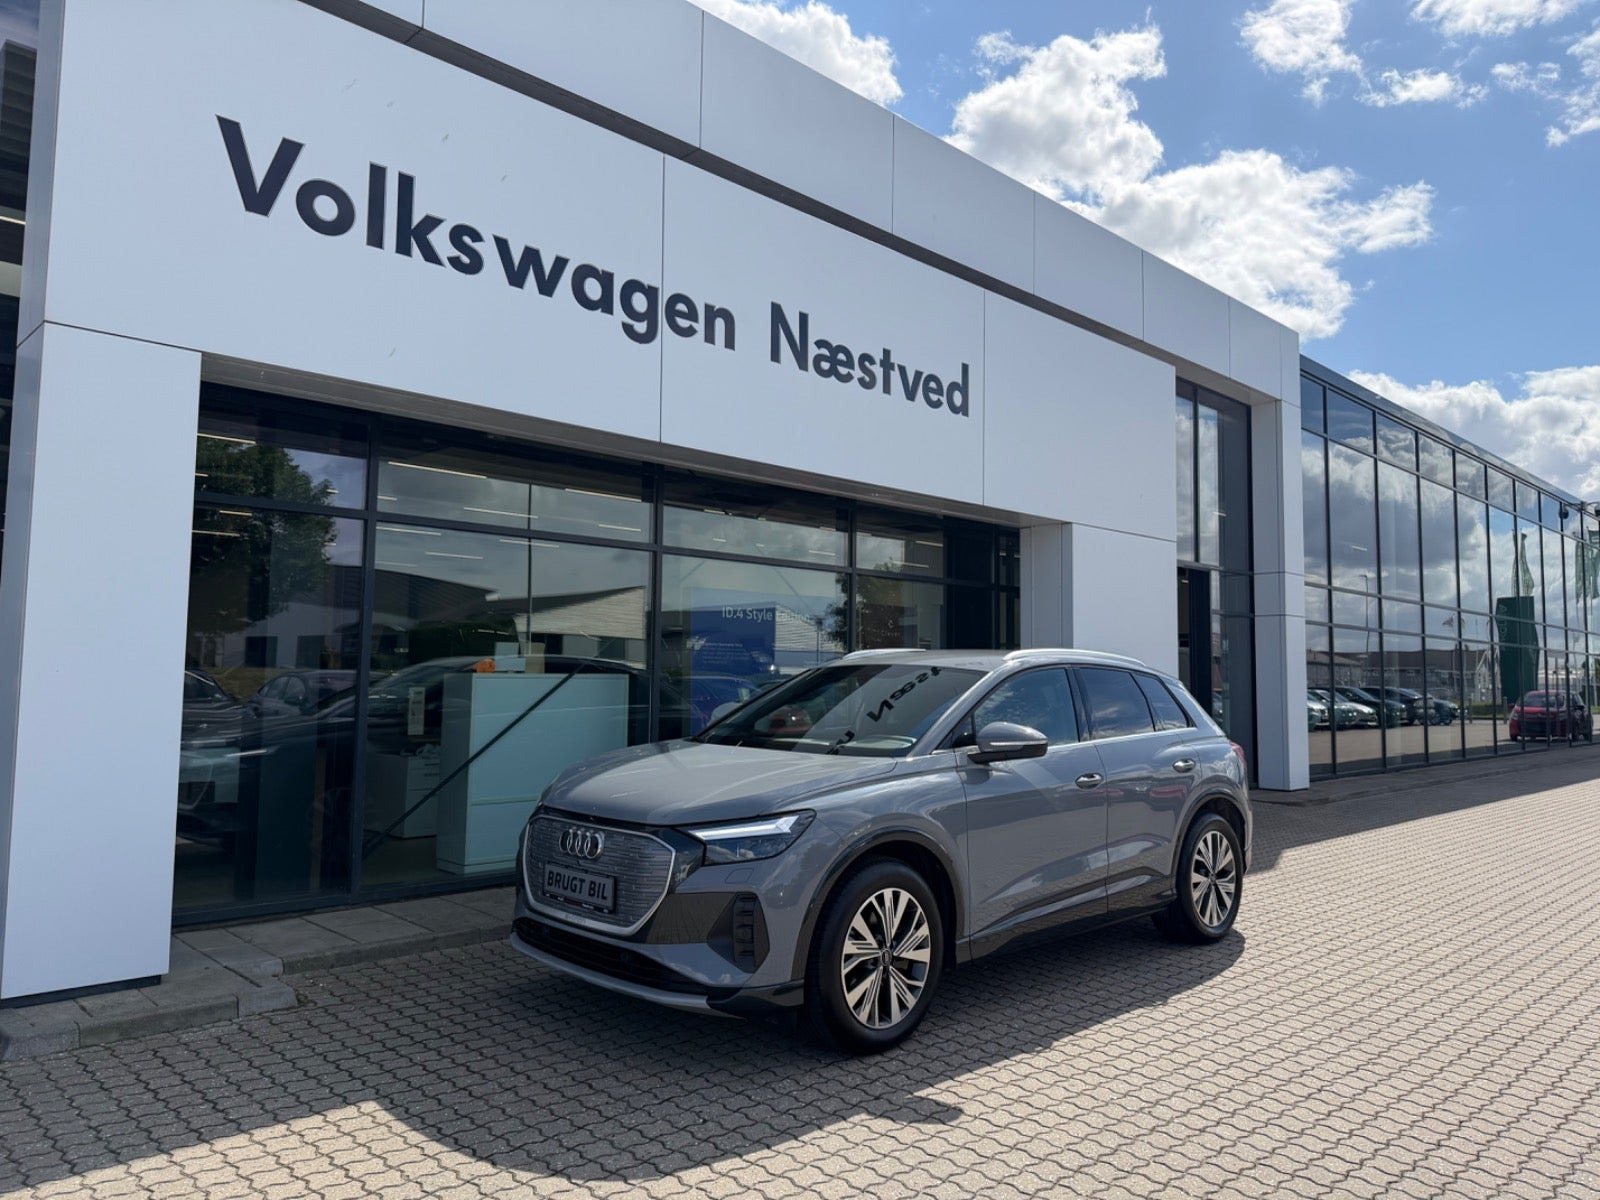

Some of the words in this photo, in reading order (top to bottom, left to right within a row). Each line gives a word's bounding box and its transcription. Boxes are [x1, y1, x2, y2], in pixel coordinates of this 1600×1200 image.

[215, 114, 736, 350] Volkswagen
[770, 300, 970, 418] Næstved
[722, 605, 744, 619] ID.4
[746, 609, 773, 623] Style
[547, 871, 586, 895] BRUGT
[588, 881, 608, 900] BIL
